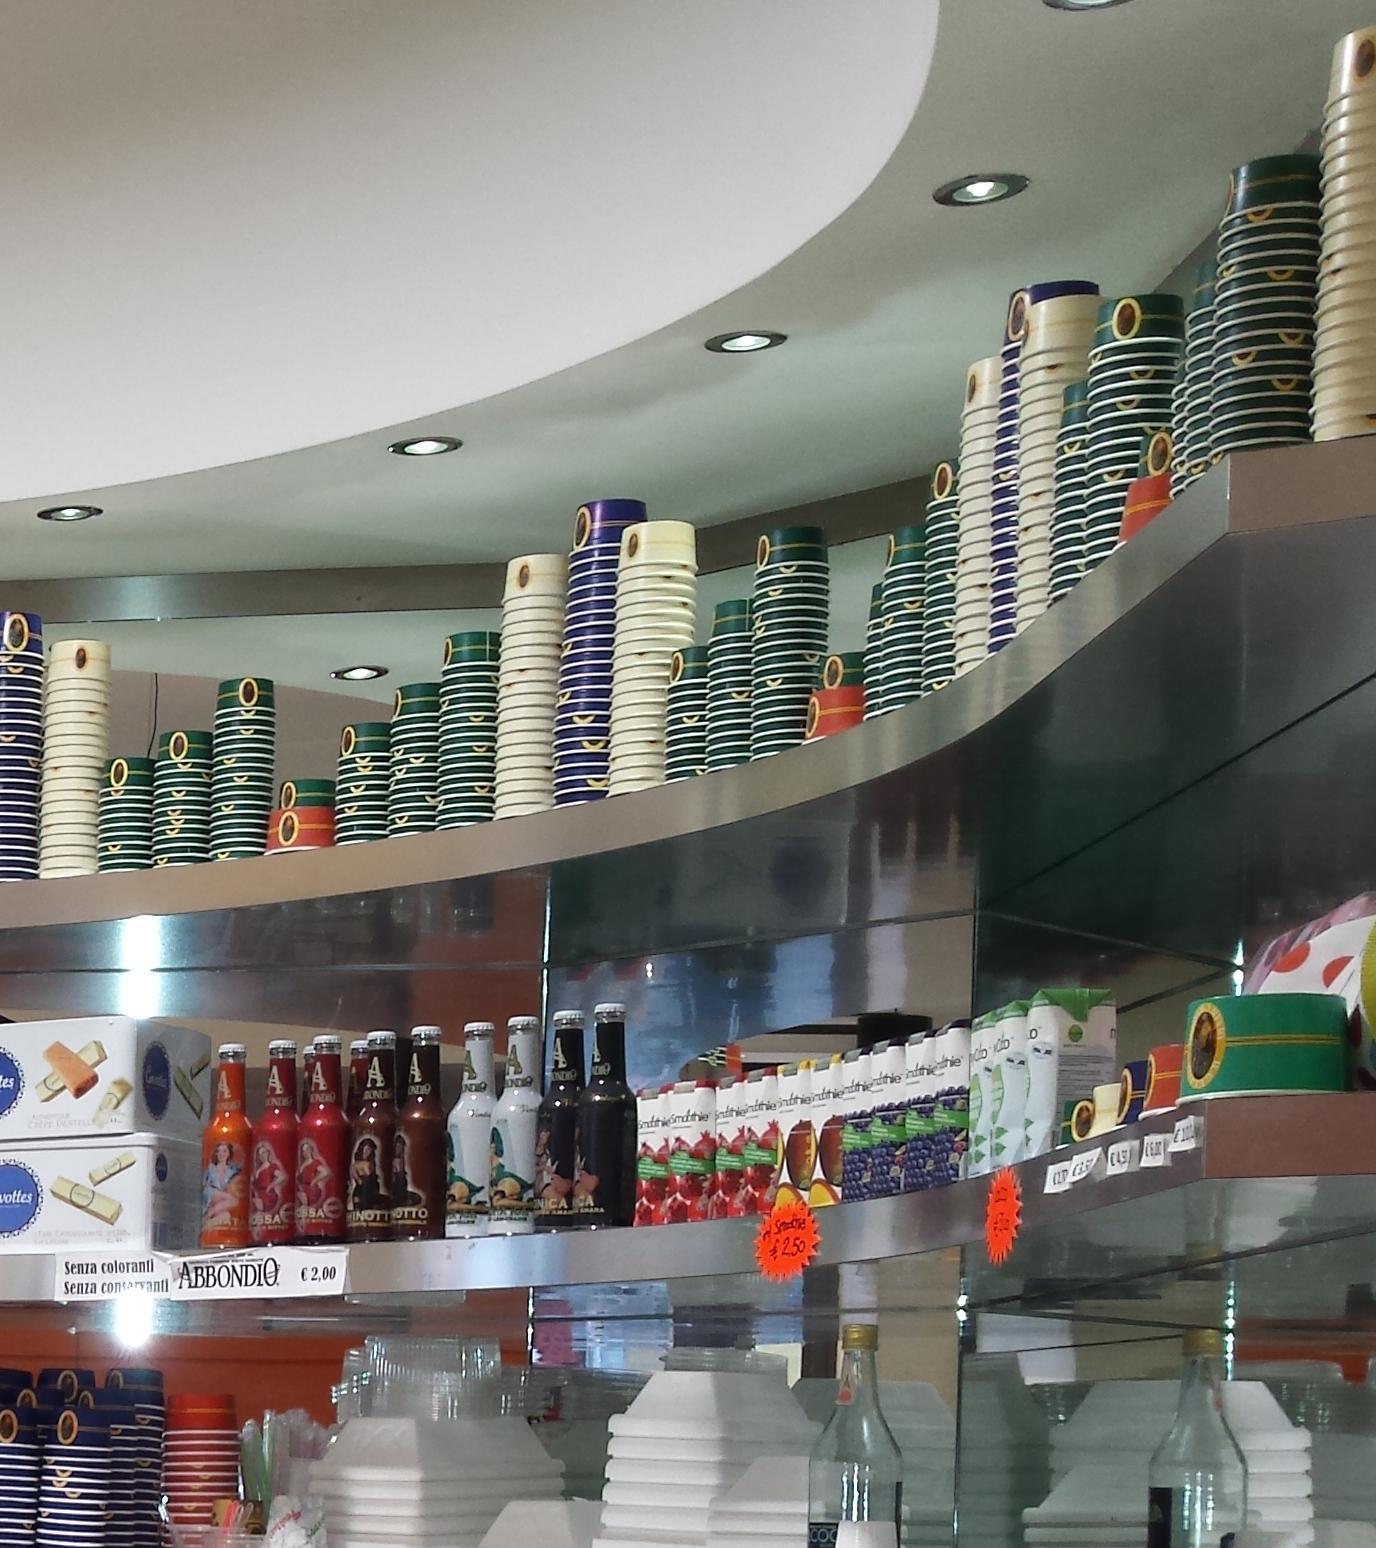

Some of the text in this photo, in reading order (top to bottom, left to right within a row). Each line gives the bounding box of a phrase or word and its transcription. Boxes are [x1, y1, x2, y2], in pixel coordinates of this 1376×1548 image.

[64, 1258, 154, 1275] Senza coloranti
[301, 1267, 308, 1281] €
[310, 1266, 337, 1283] 2,00
[64, 1279, 97, 1295] Senza
